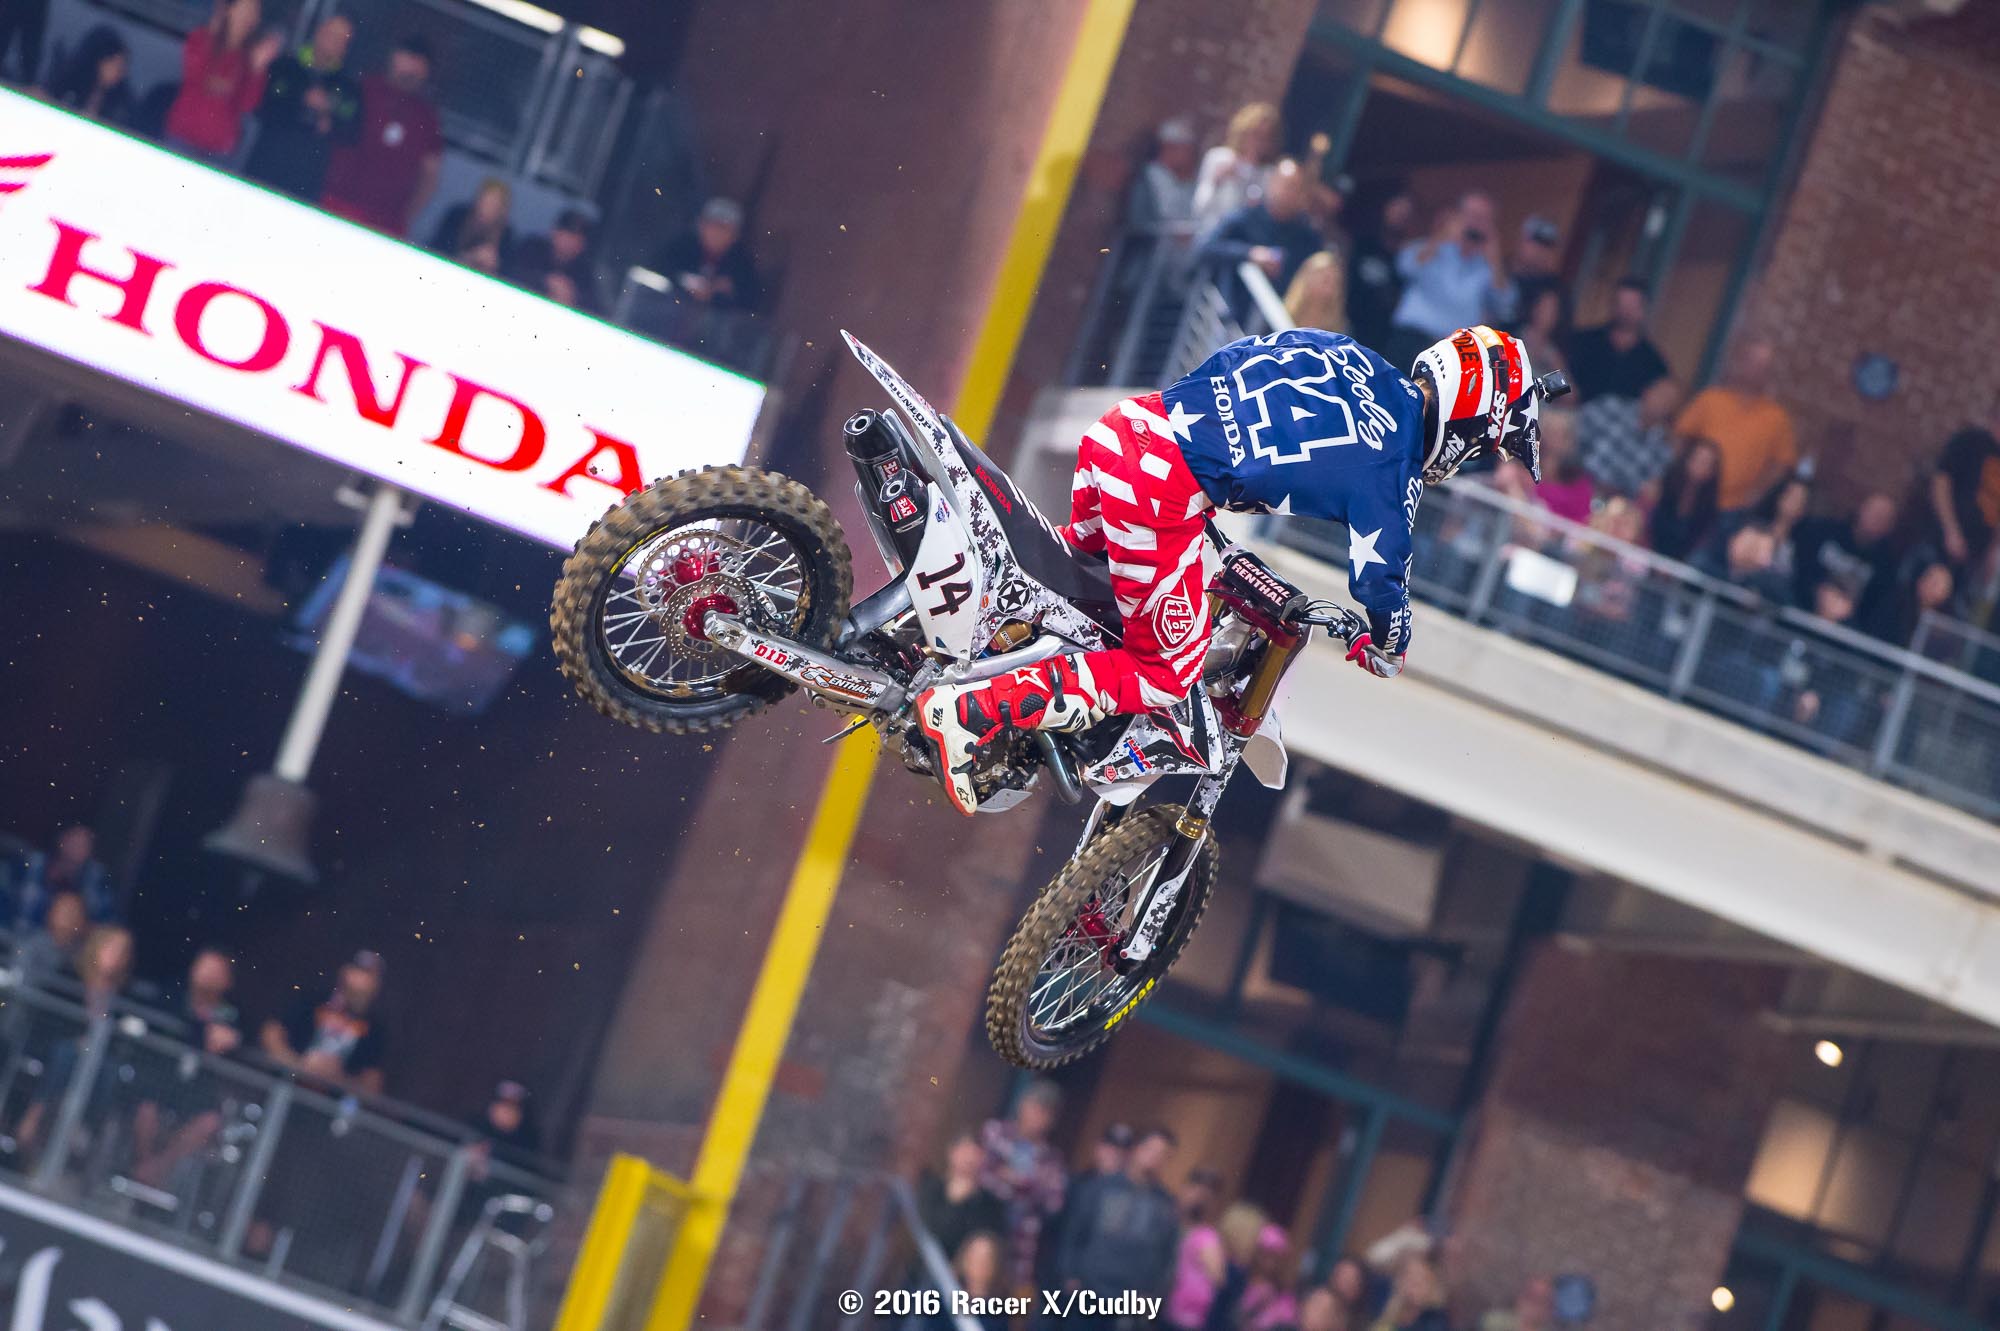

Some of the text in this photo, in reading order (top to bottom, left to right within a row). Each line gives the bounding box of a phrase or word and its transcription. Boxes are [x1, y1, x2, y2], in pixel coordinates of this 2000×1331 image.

[26, 217, 644, 505] HONDA
[1210, 376, 1246, 468] HONDA
[1232, 348, 1358, 466] 14
[1325, 345, 1397, 451] Seely
[975, 464, 1012, 515] HONDA
[916, 552, 973, 616] 14
[1231, 563, 1284, 606] RENTHAL
[1237, 557, 1291, 598] RENTHAL
[754, 644, 789, 666] D.I.D
[1123, 738, 1152, 773] HRC
